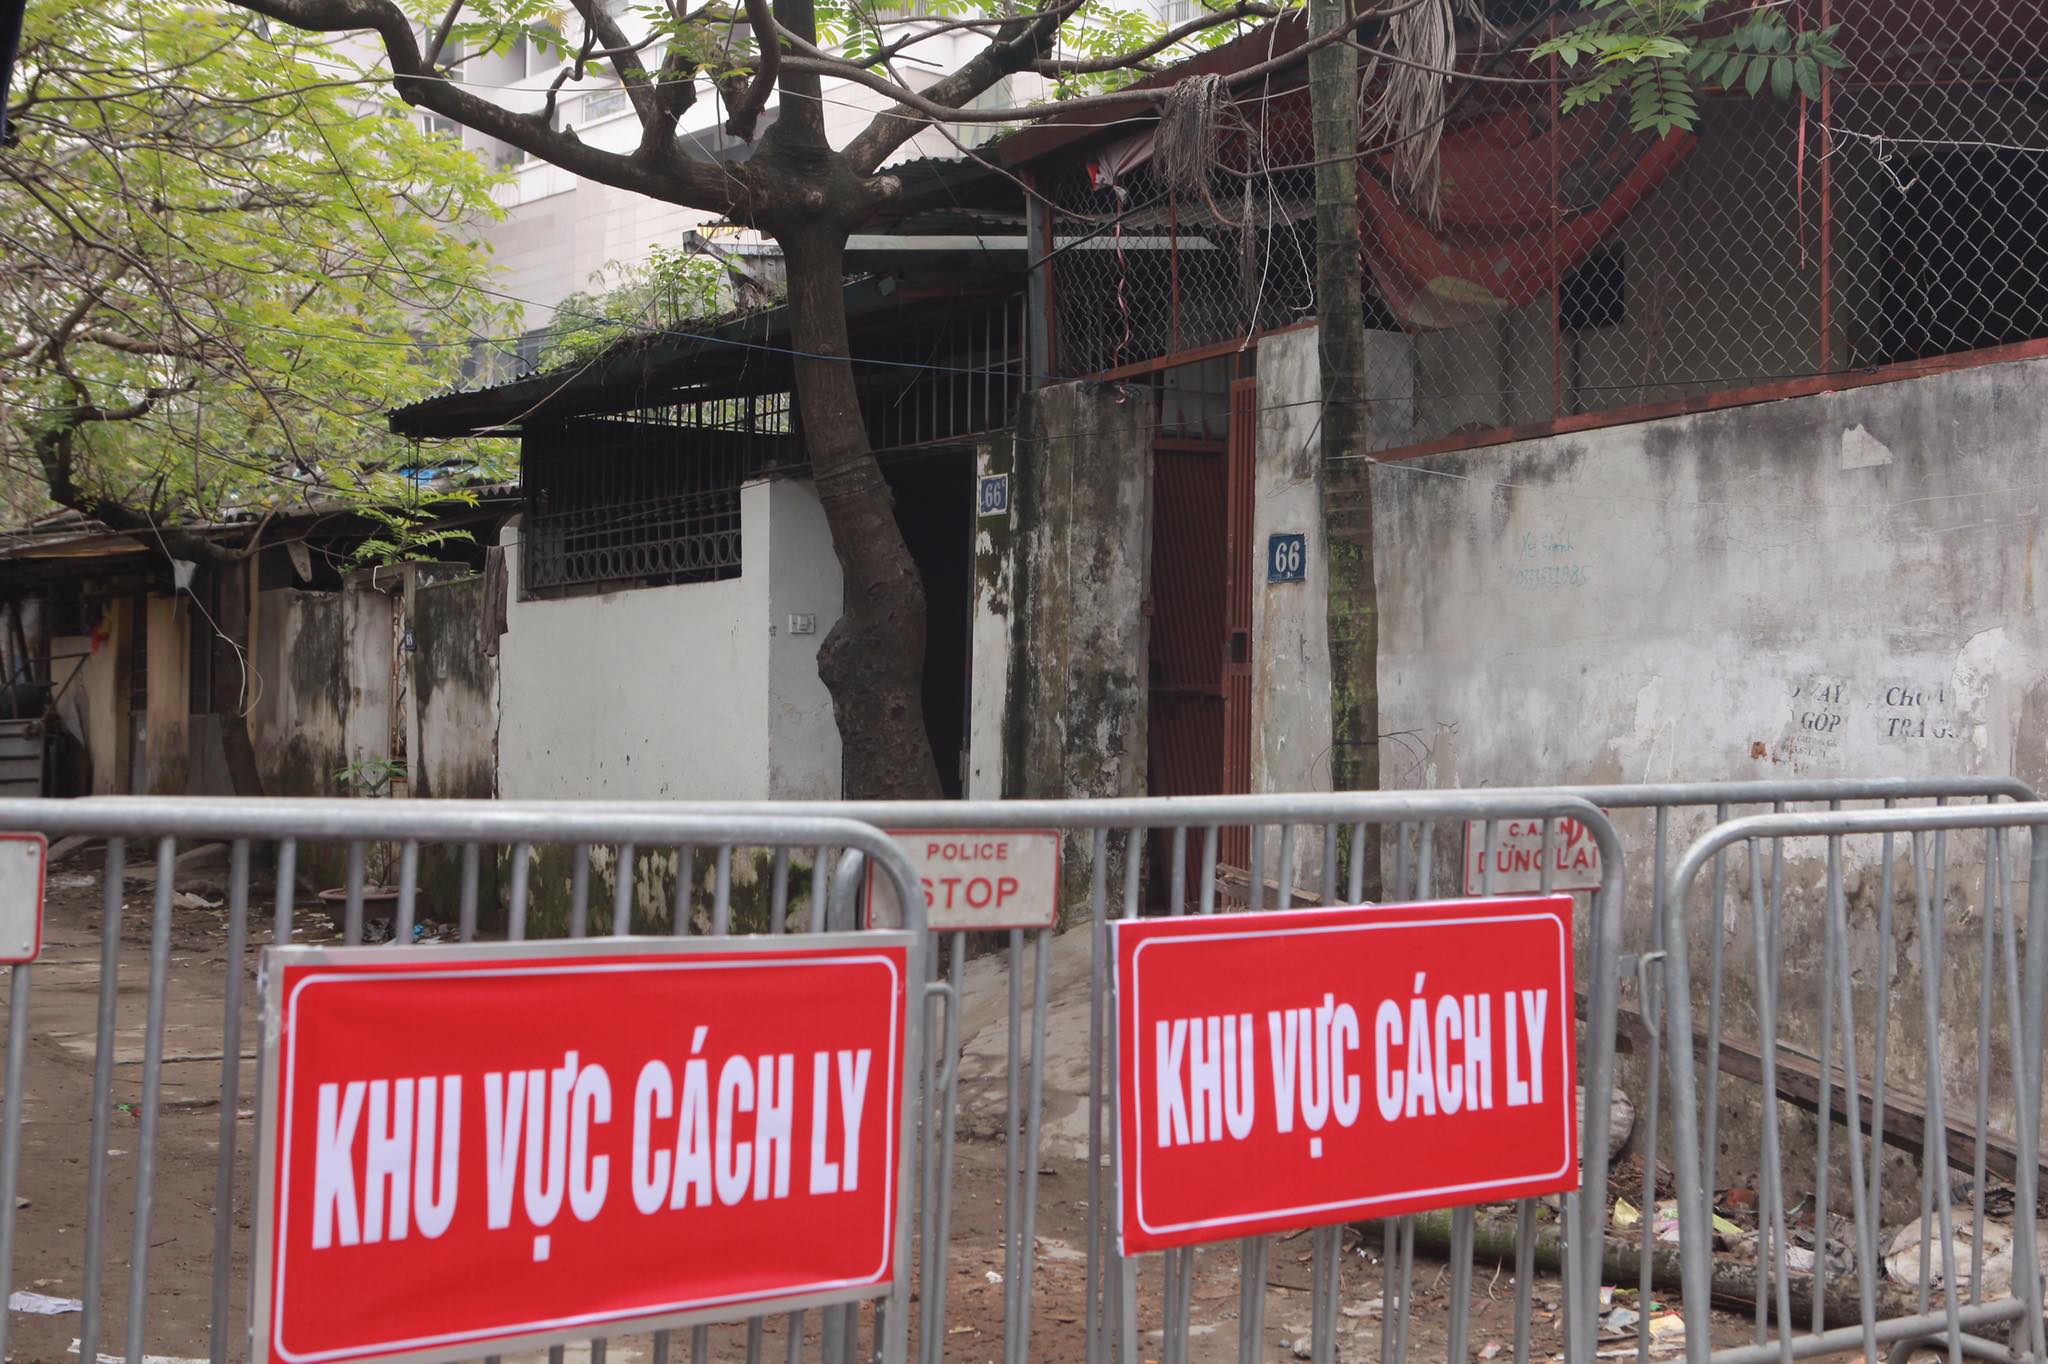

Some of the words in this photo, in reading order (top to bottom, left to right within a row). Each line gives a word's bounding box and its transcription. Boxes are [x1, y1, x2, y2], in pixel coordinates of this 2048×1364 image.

[1275, 540, 1300, 573] 66
[1800, 707, 1841, 733] GÓP
[926, 842, 1009, 861] POLICE
[1556, 847, 1598, 876] LẠI
[1155, 1013, 1255, 1148] KHU
[1267, 992, 1361, 1159] VỰC
[1375, 971, 1493, 1122] CÁCH
[1504, 988, 1548, 1107] LY
[311, 1074, 462, 1250] KHU
[484, 1050, 612, 1262] VỰC
[631, 1025, 794, 1215] CÁCH
[809, 1048, 873, 1196] LY
